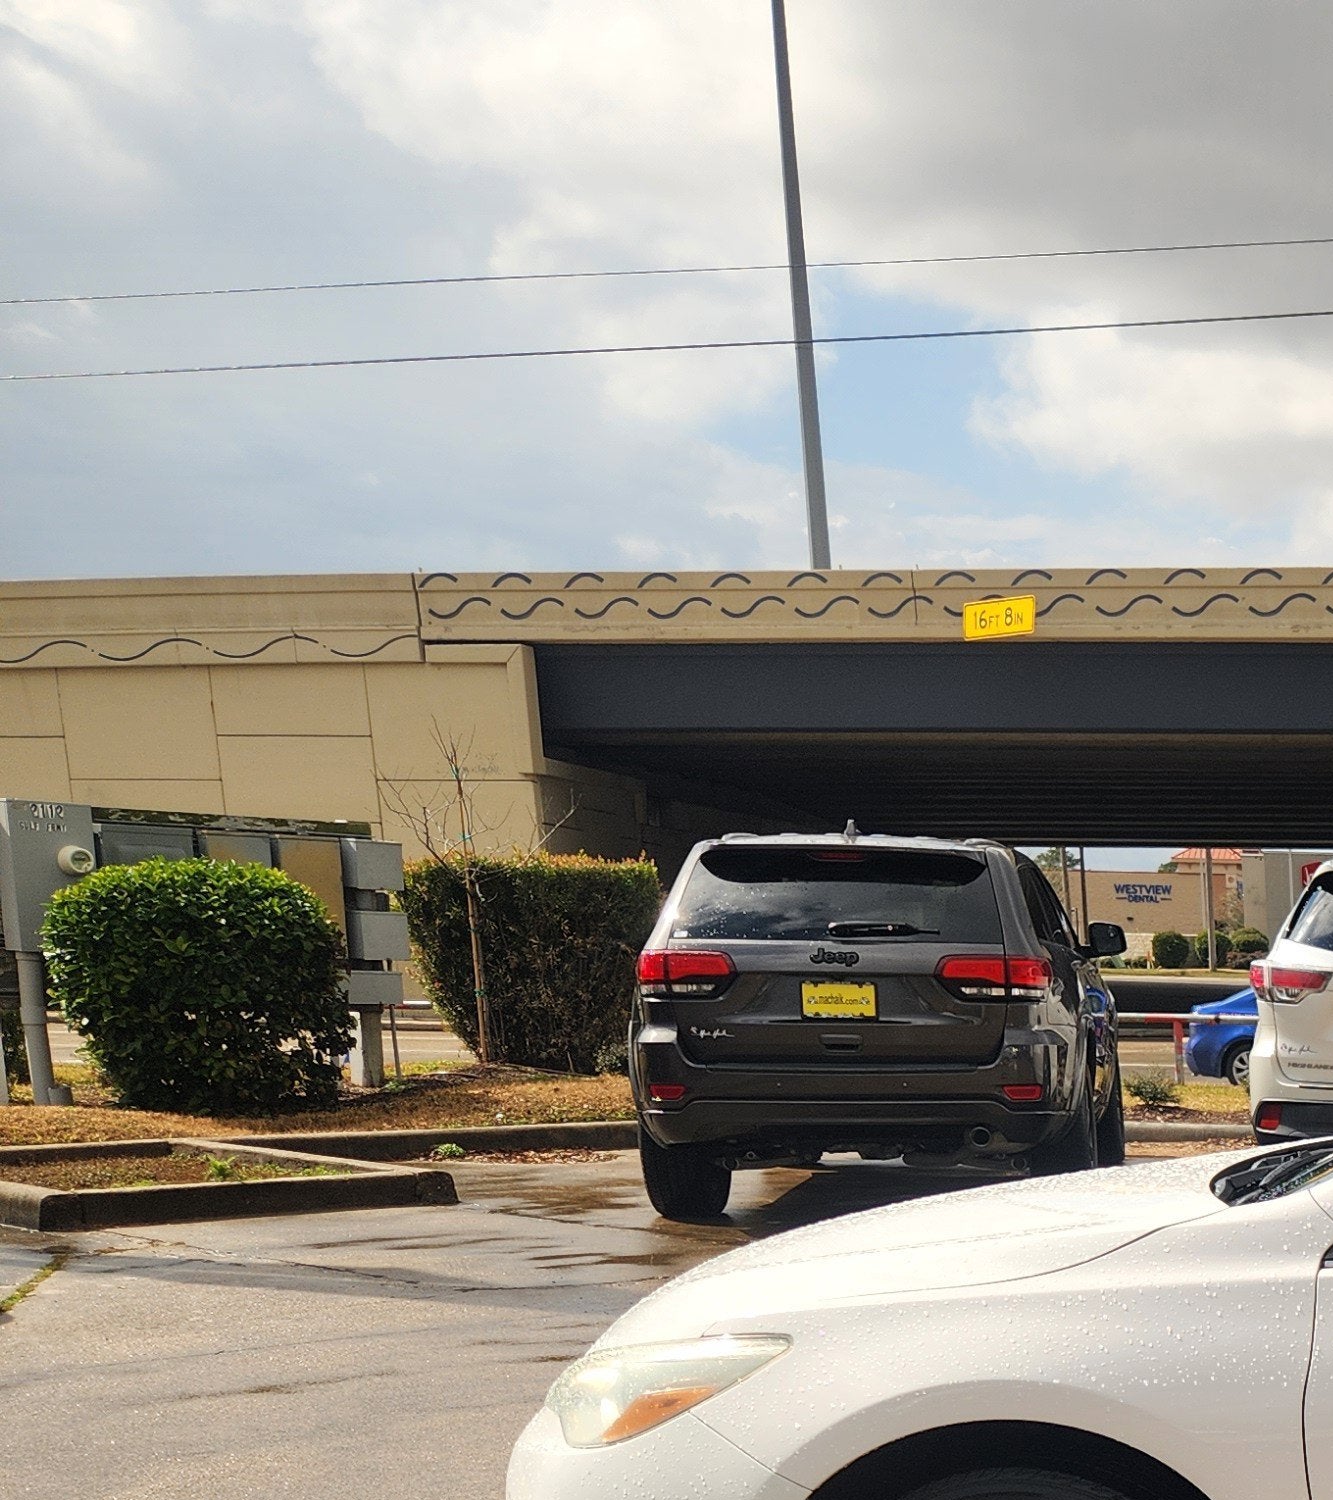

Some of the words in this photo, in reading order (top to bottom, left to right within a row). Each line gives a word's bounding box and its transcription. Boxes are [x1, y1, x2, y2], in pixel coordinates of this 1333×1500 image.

[30, 803, 65, 819] 2112
[1113, 883, 1172, 895] WESTVIEW
[1127, 894, 1160, 904] DENTAL
[809, 947, 860, 967] Jeep
